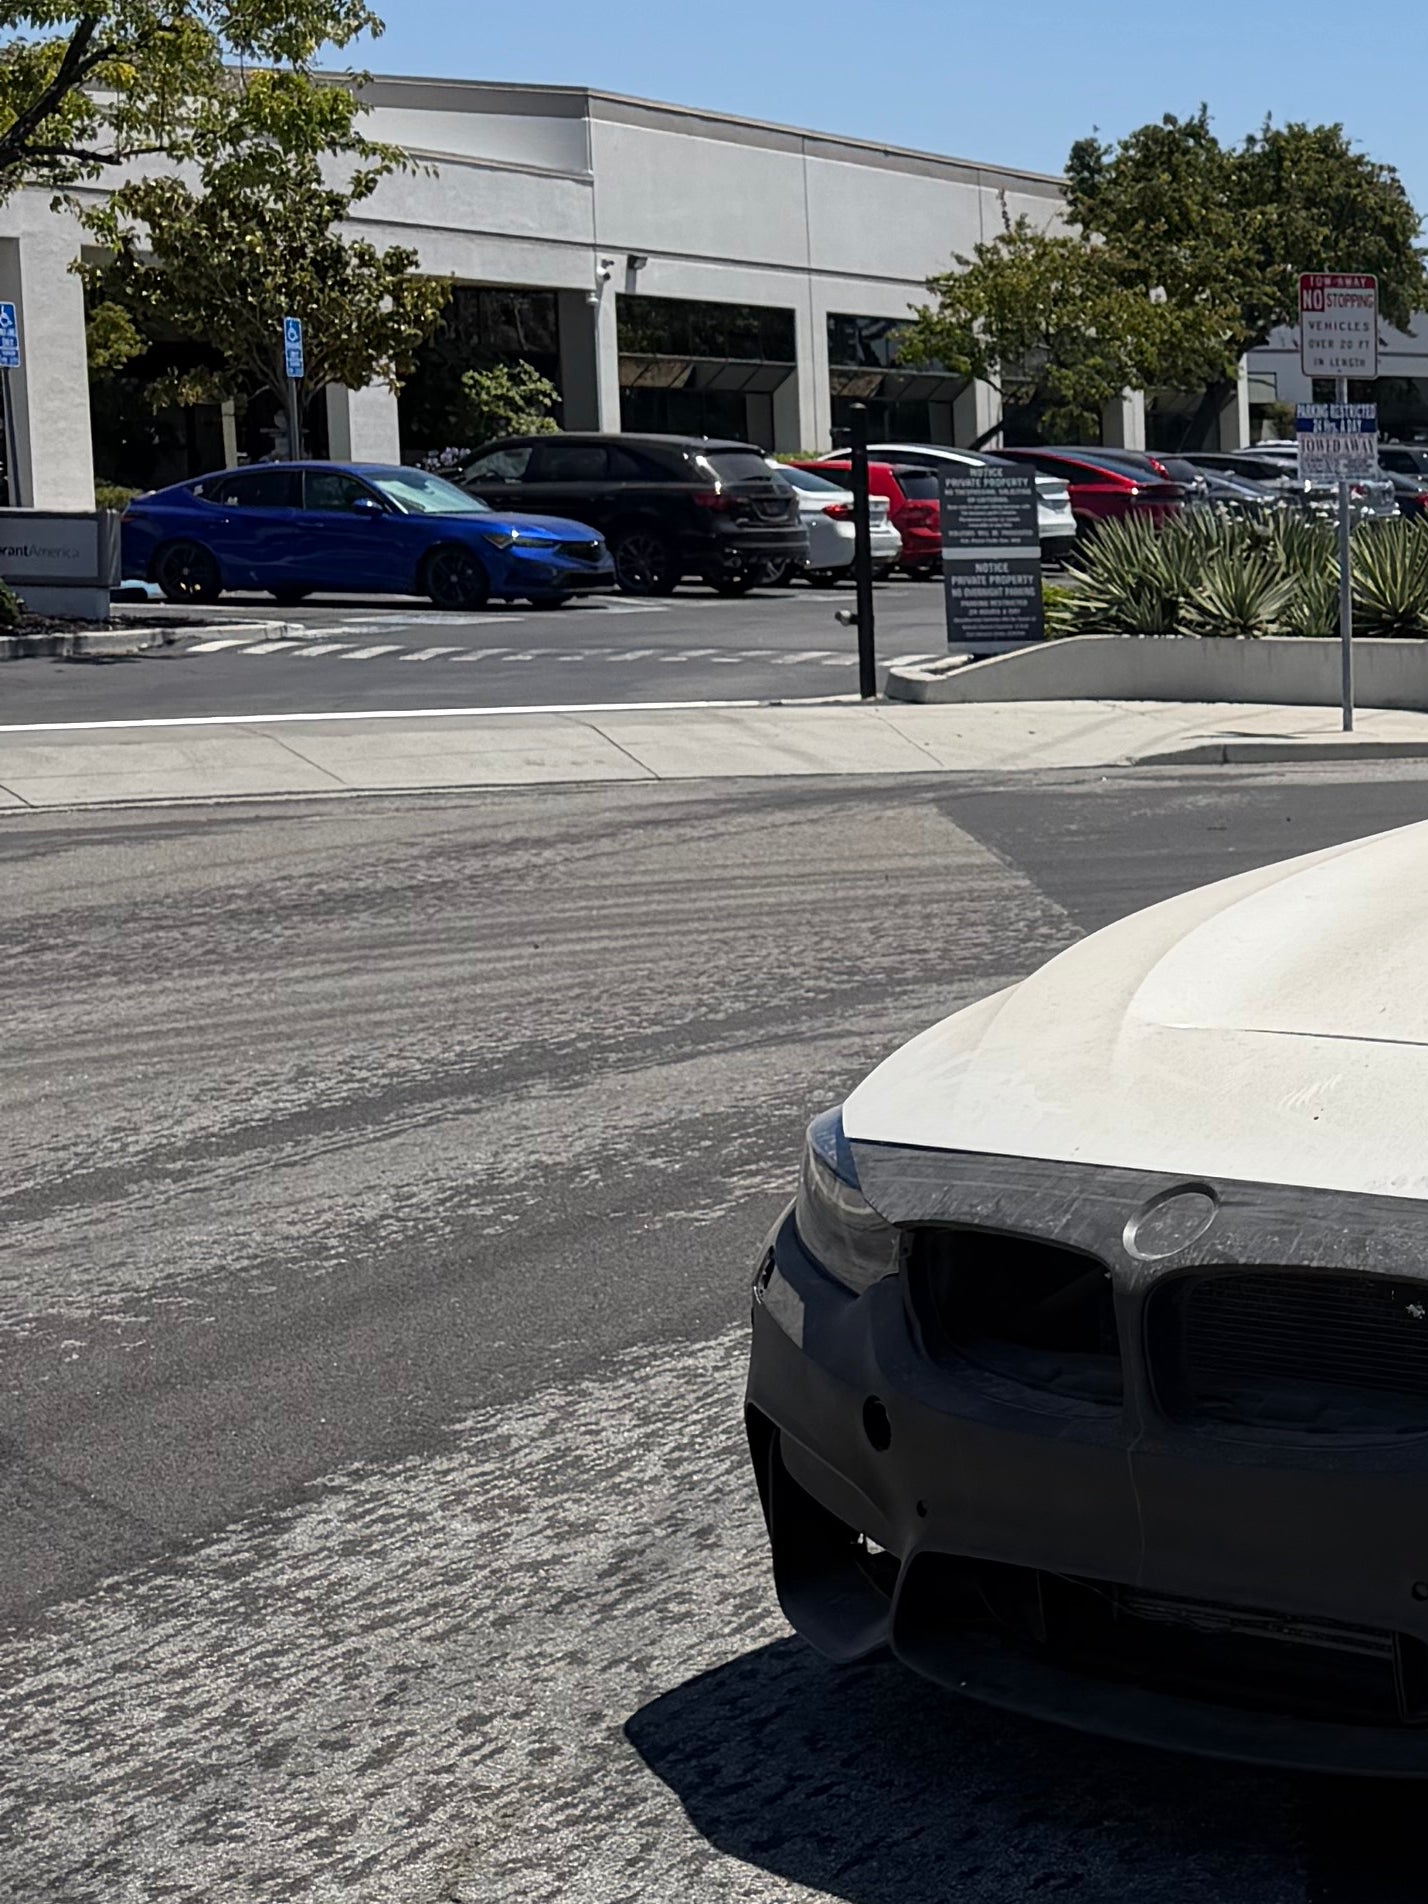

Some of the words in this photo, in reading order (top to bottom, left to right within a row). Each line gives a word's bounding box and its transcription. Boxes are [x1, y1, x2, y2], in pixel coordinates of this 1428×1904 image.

[1303, 289, 1323, 310] NO
[1326, 293, 1374, 309] STOPPING
[1308, 321, 1370, 332] VEHICLES
[1308, 339, 1334, 349] OVER
[1340, 339, 1353, 350] 20
[1359, 340, 1370, 350] FT
[1313, 358, 1325, 367] IN
[1330, 357, 1366, 368] LENGTH
[1301, 439, 1341, 453] TOWED
[1343, 438, 1374, 453] AWAY
[975, 562, 1009, 573] NOTICE
[951, 575, 987, 586] PRIVATE
[989, 575, 1034, 584] PROPERTY
